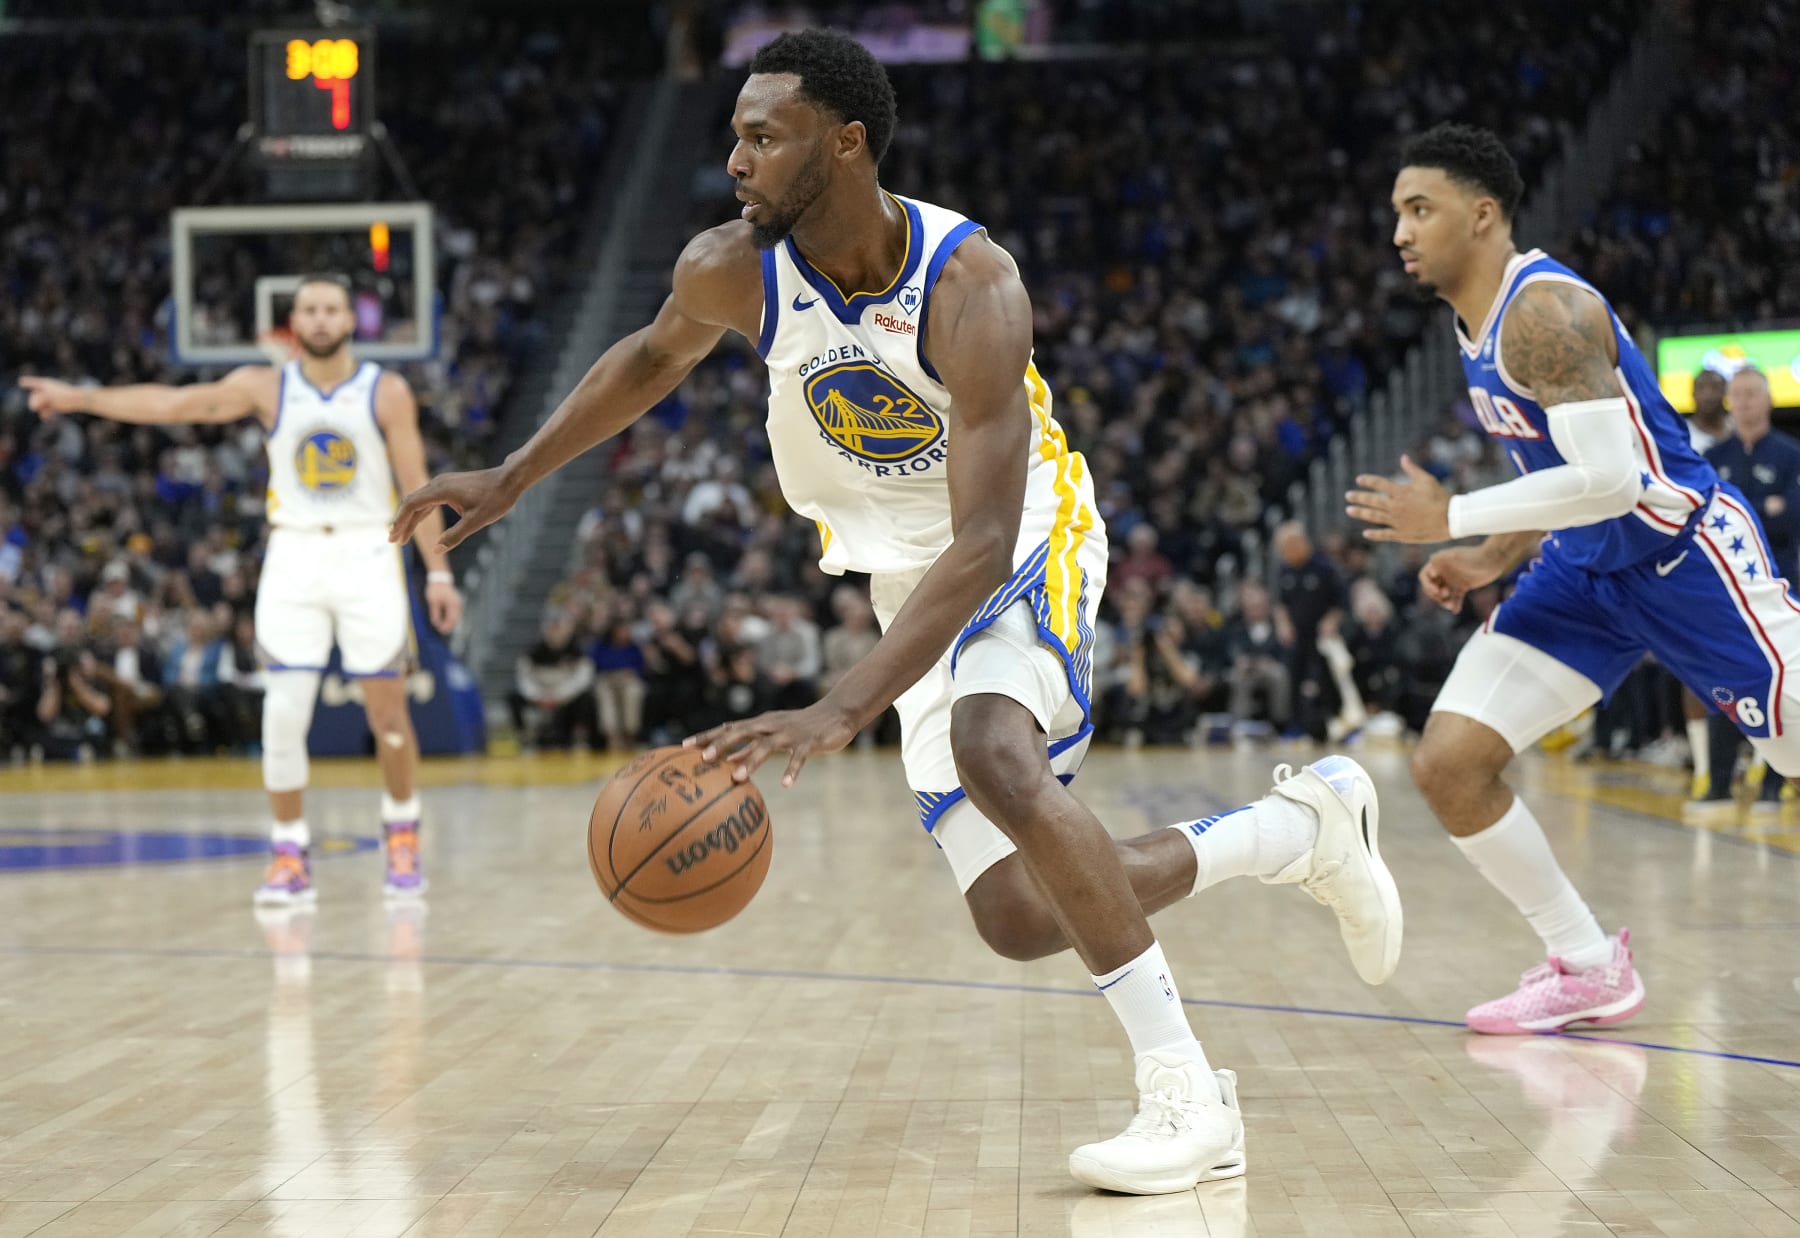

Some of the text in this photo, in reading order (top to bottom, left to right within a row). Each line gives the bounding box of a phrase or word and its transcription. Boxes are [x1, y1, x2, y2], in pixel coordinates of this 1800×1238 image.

[905, 294, 916, 306] DM
[875, 313, 915, 336] Rakuten
[799, 344, 865, 377] GOLDEN
[873, 395, 924, 418] 22
[664, 795, 765, 875] Wilson
